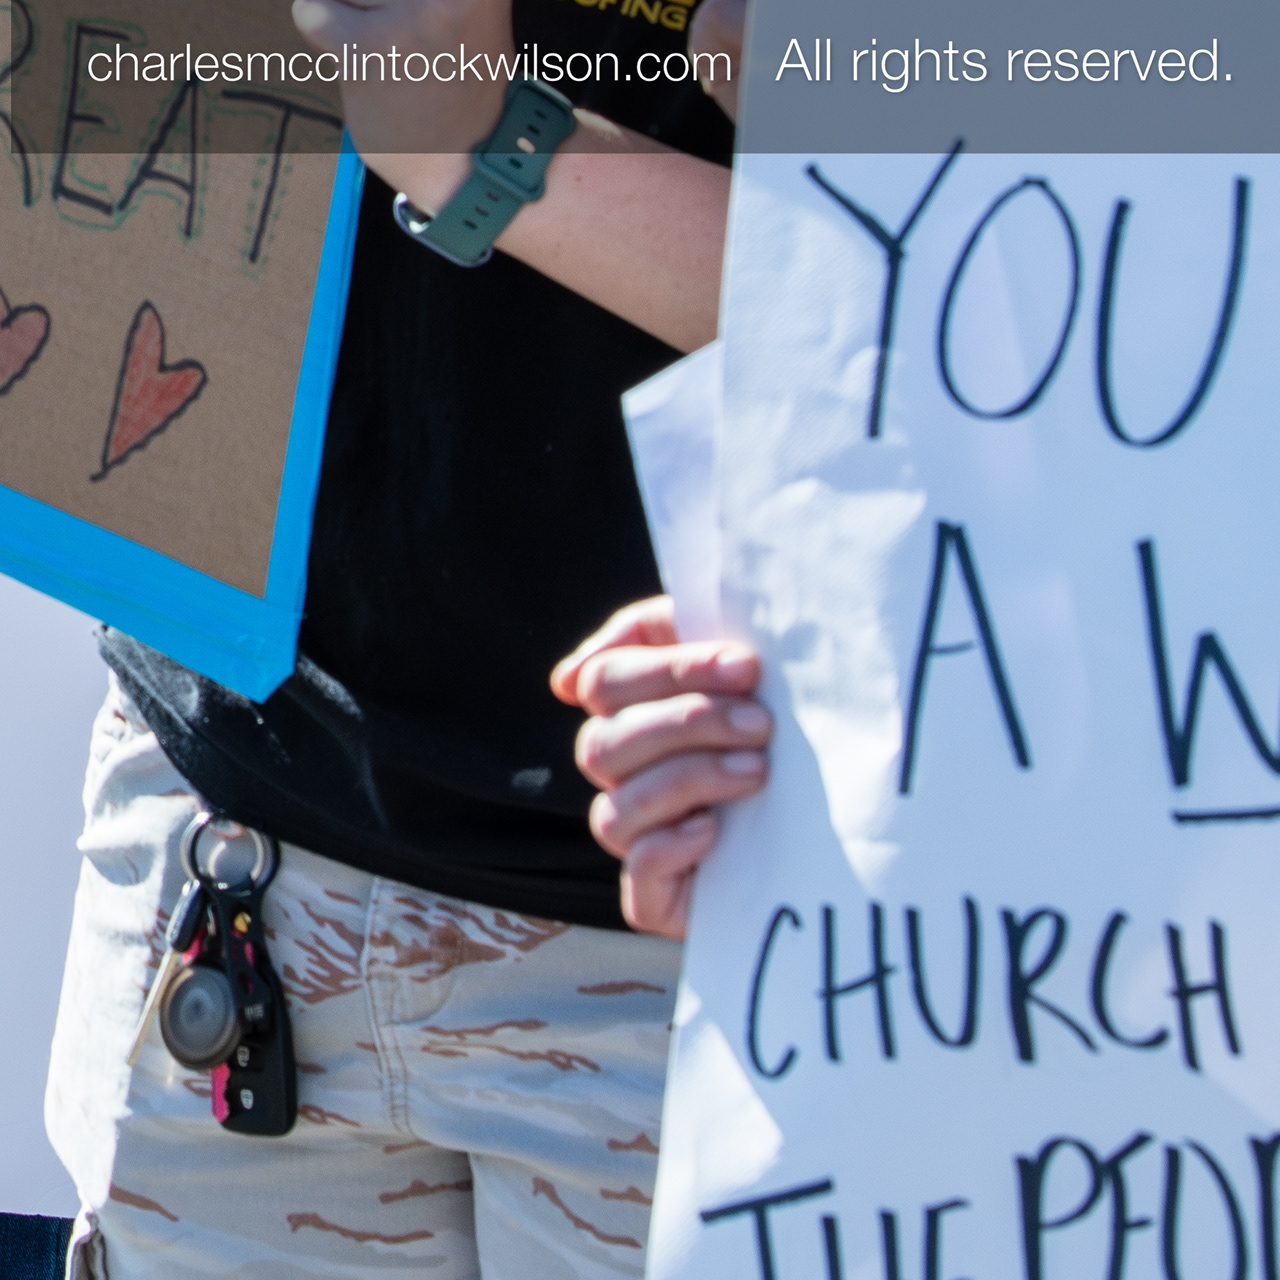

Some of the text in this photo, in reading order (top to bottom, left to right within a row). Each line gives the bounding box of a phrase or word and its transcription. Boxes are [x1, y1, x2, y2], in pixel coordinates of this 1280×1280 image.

[804, 138, 1252, 448] YOU
[897, 519, 1031, 797] A
[745, 894, 1244, 1080] CHURCH
